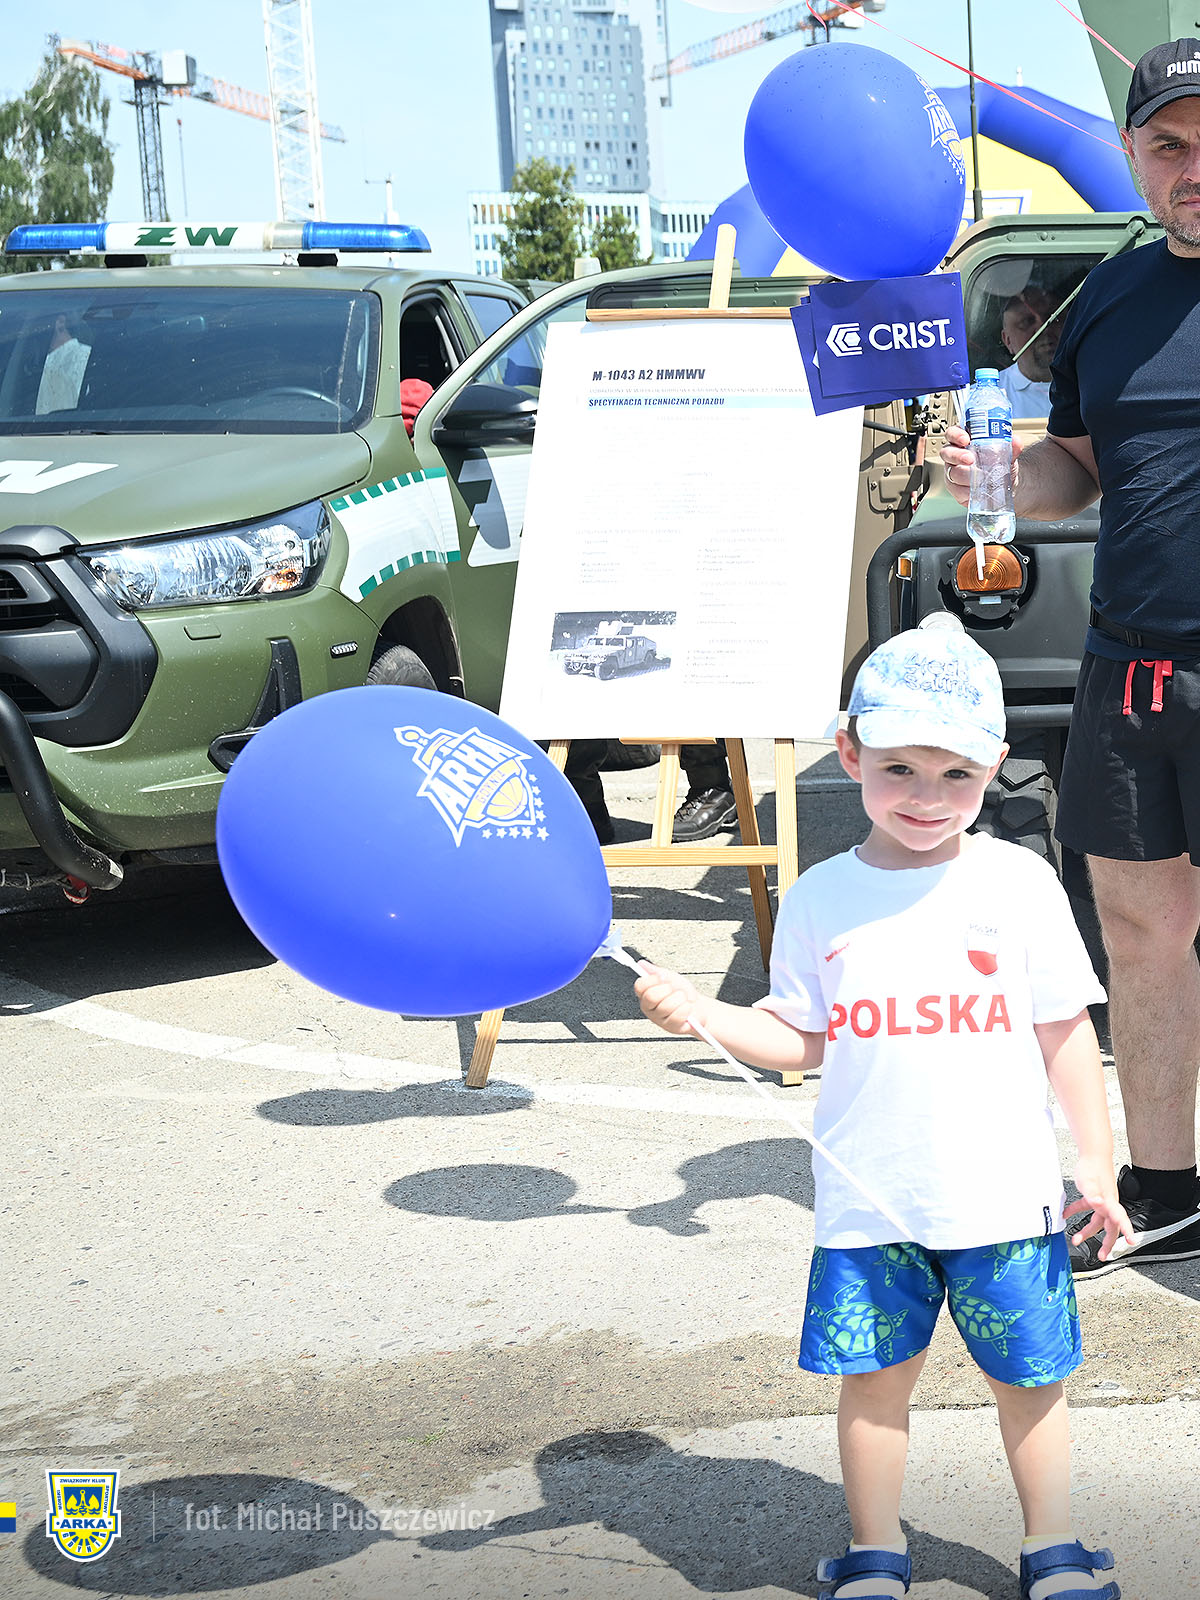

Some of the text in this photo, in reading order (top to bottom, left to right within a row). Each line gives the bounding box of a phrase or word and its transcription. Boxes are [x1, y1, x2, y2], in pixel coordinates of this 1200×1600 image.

[868, 318, 951, 351] CRIST
[592, 369, 706, 382] M-1043 A2 HMMWV
[588, 397, 725, 407] SPECYFIKACJA TECHNICZNA POJAZDU
[427, 734, 522, 825] ARKA
[827, 994, 1012, 1042] POLSKA
